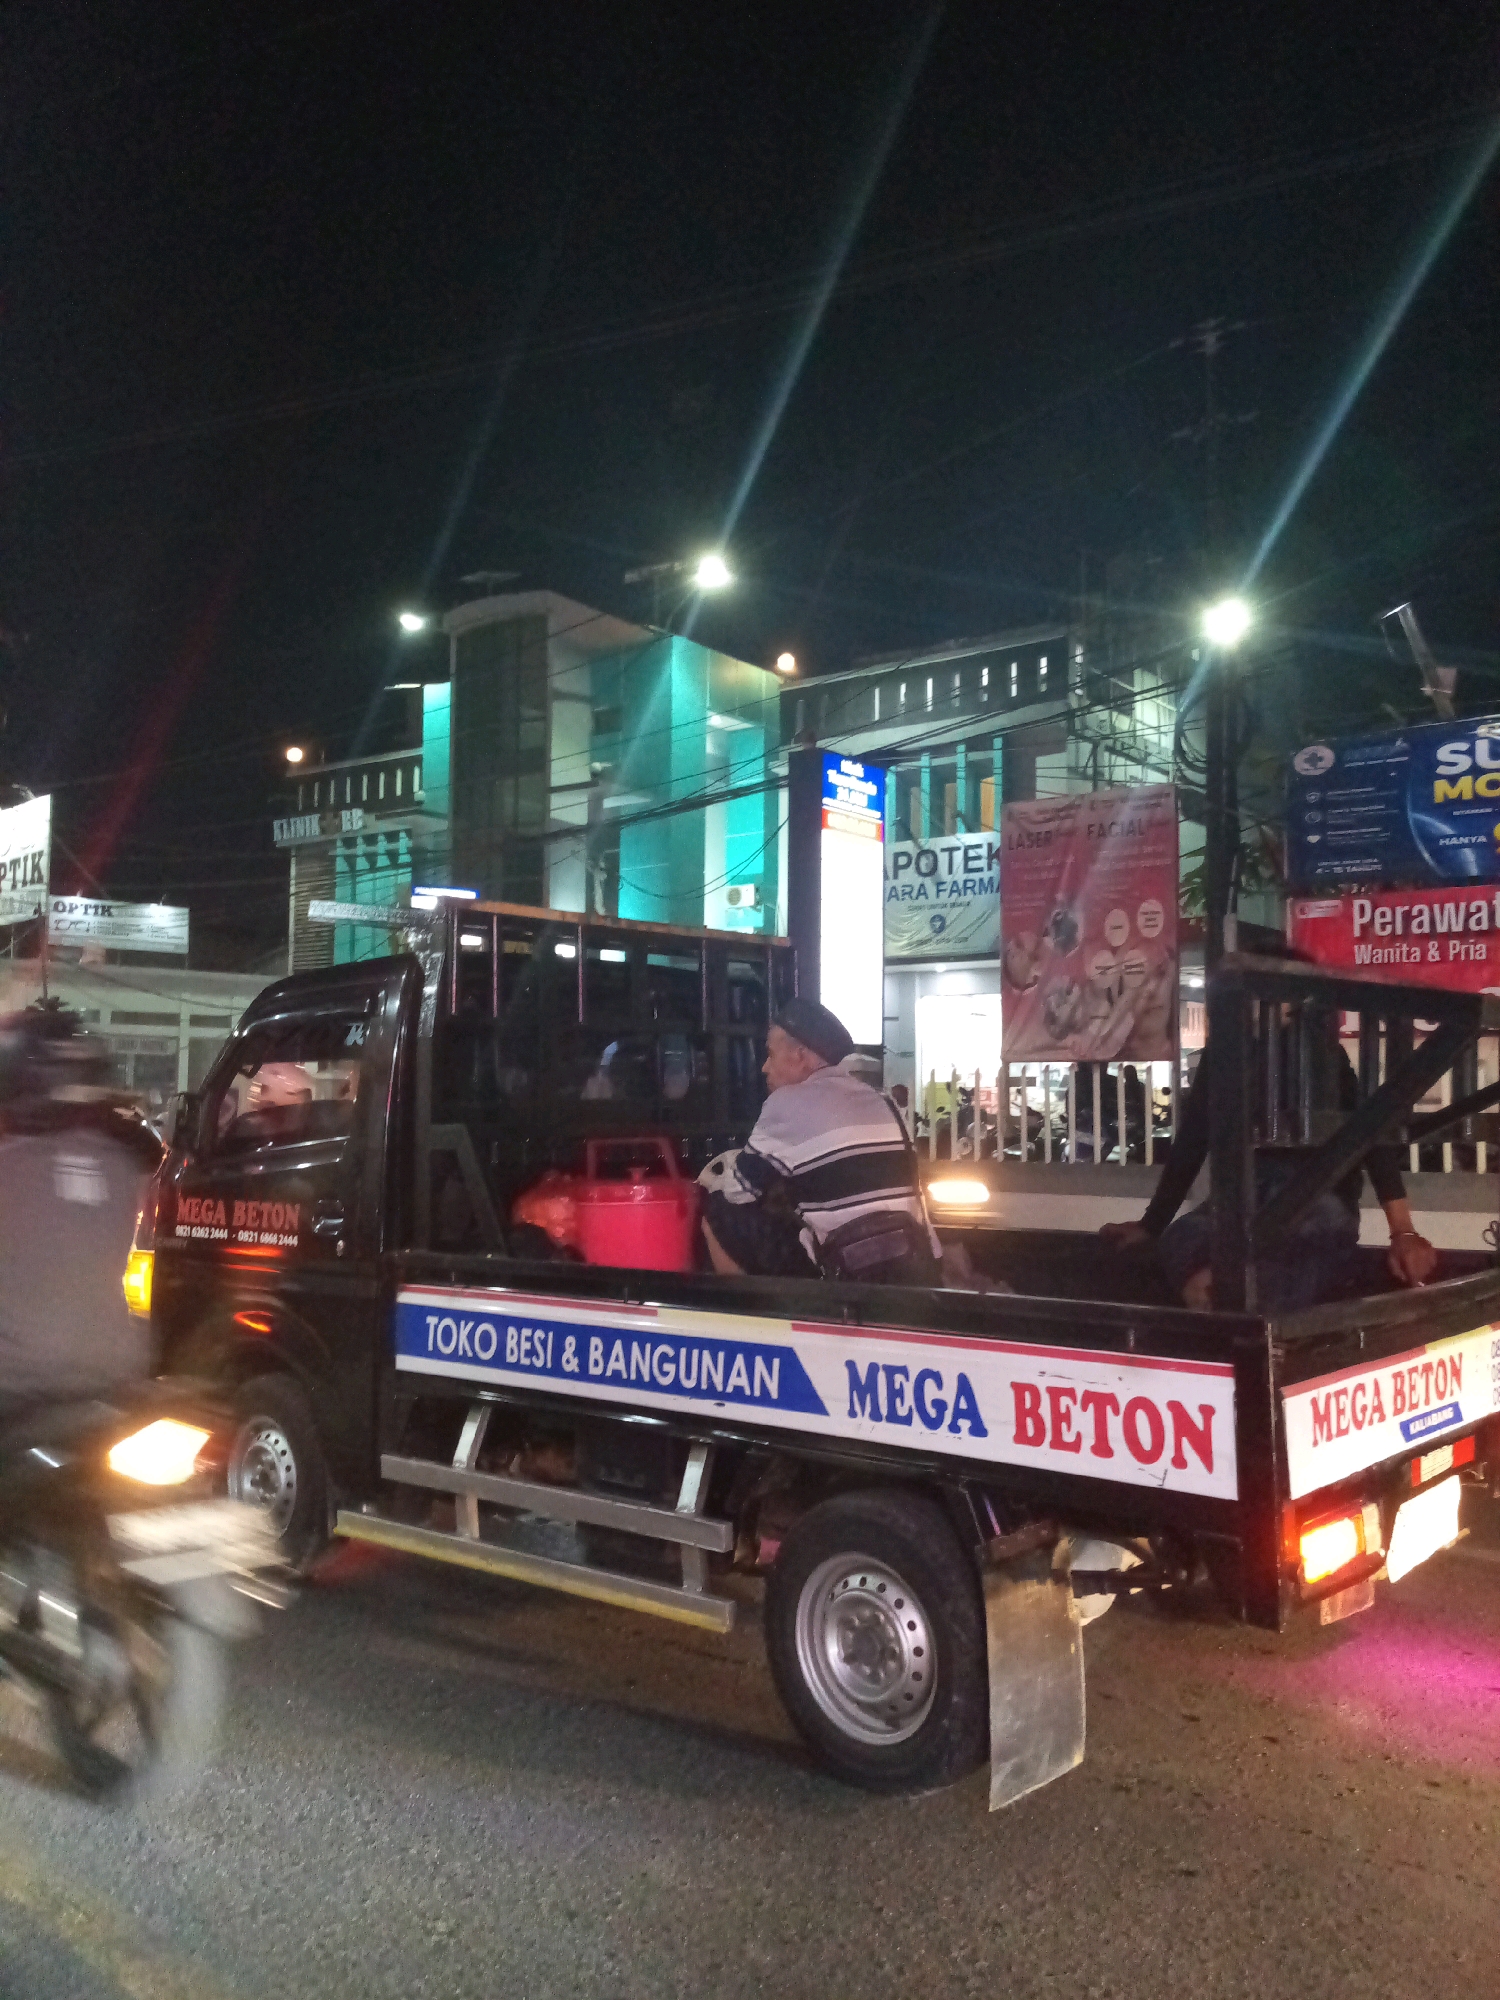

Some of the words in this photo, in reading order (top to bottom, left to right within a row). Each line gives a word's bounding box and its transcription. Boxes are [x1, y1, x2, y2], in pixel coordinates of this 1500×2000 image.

[1087, 818, 1145, 840] FACIAL
[1008, 830, 1053, 851] LASER
[1439, 835, 1488, 846] HANYA
[53, 901, 113, 917] OPTIK
[1354, 942, 1421, 965] Wanita
[1428, 940, 1441, 962] &
[1449, 939, 1487, 962] Pria
[177, 1198, 226, 1226] MEGA
[232, 1200, 300, 1231] BETON
[238, 1230, 258, 1242] 0821
[425, 1315, 497, 1361] TOKO
[505, 1325, 553, 1369] BESI
[561, 1335, 580, 1373] &
[588, 1338, 781, 1400] BANGUNAN
[844, 1359, 989, 1438] MEGA
[1010, 1380, 1216, 1475] BETON
[1310, 1378, 1386, 1448] MEGA
[1391, 1352, 1463, 1417] BETON
